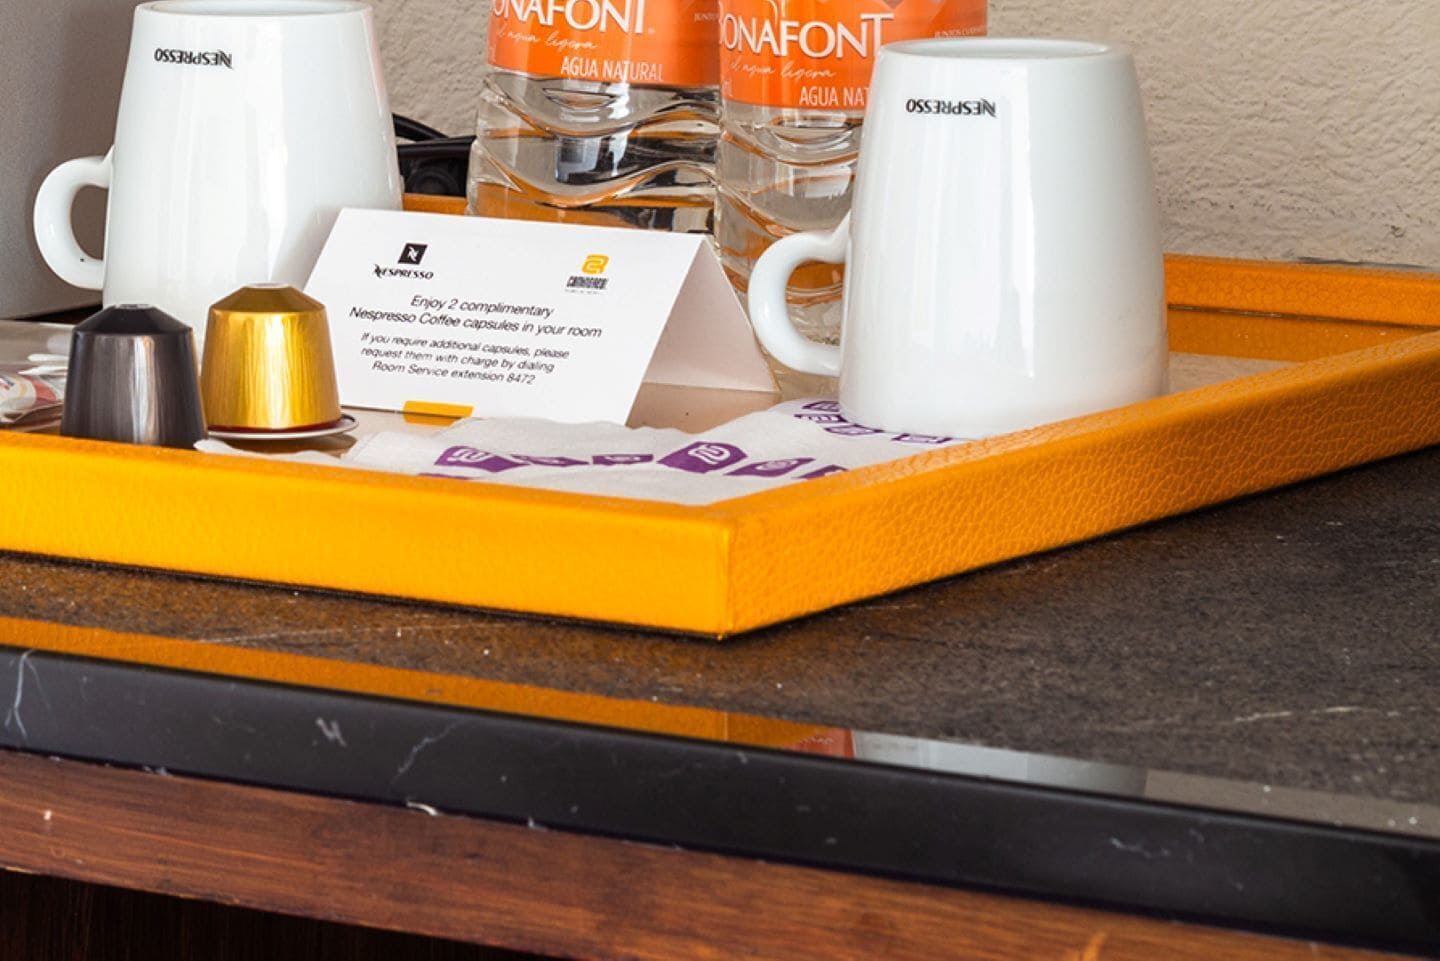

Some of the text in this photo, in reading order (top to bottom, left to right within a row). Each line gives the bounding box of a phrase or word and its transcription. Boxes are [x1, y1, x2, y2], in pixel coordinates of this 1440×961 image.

[154, 48, 233, 69] NESPRESSO
[561, 56, 663, 82] AGUA NATURAL
[799, 86, 838, 107] AGUA
[905, 98, 997, 118] NESPRESSO
[373, 264, 434, 280] NESPRESSO
[411, 295, 554, 319] Enjoy 2 complimentary
[350, 306, 602, 338] Nespresso Coffee capsules in your room
[361, 332, 570, 359] If you require additional capsules, please
[361, 347, 555, 374] request them with charge by dialing
[372, 360, 536, 385] Room Service extension 8472
